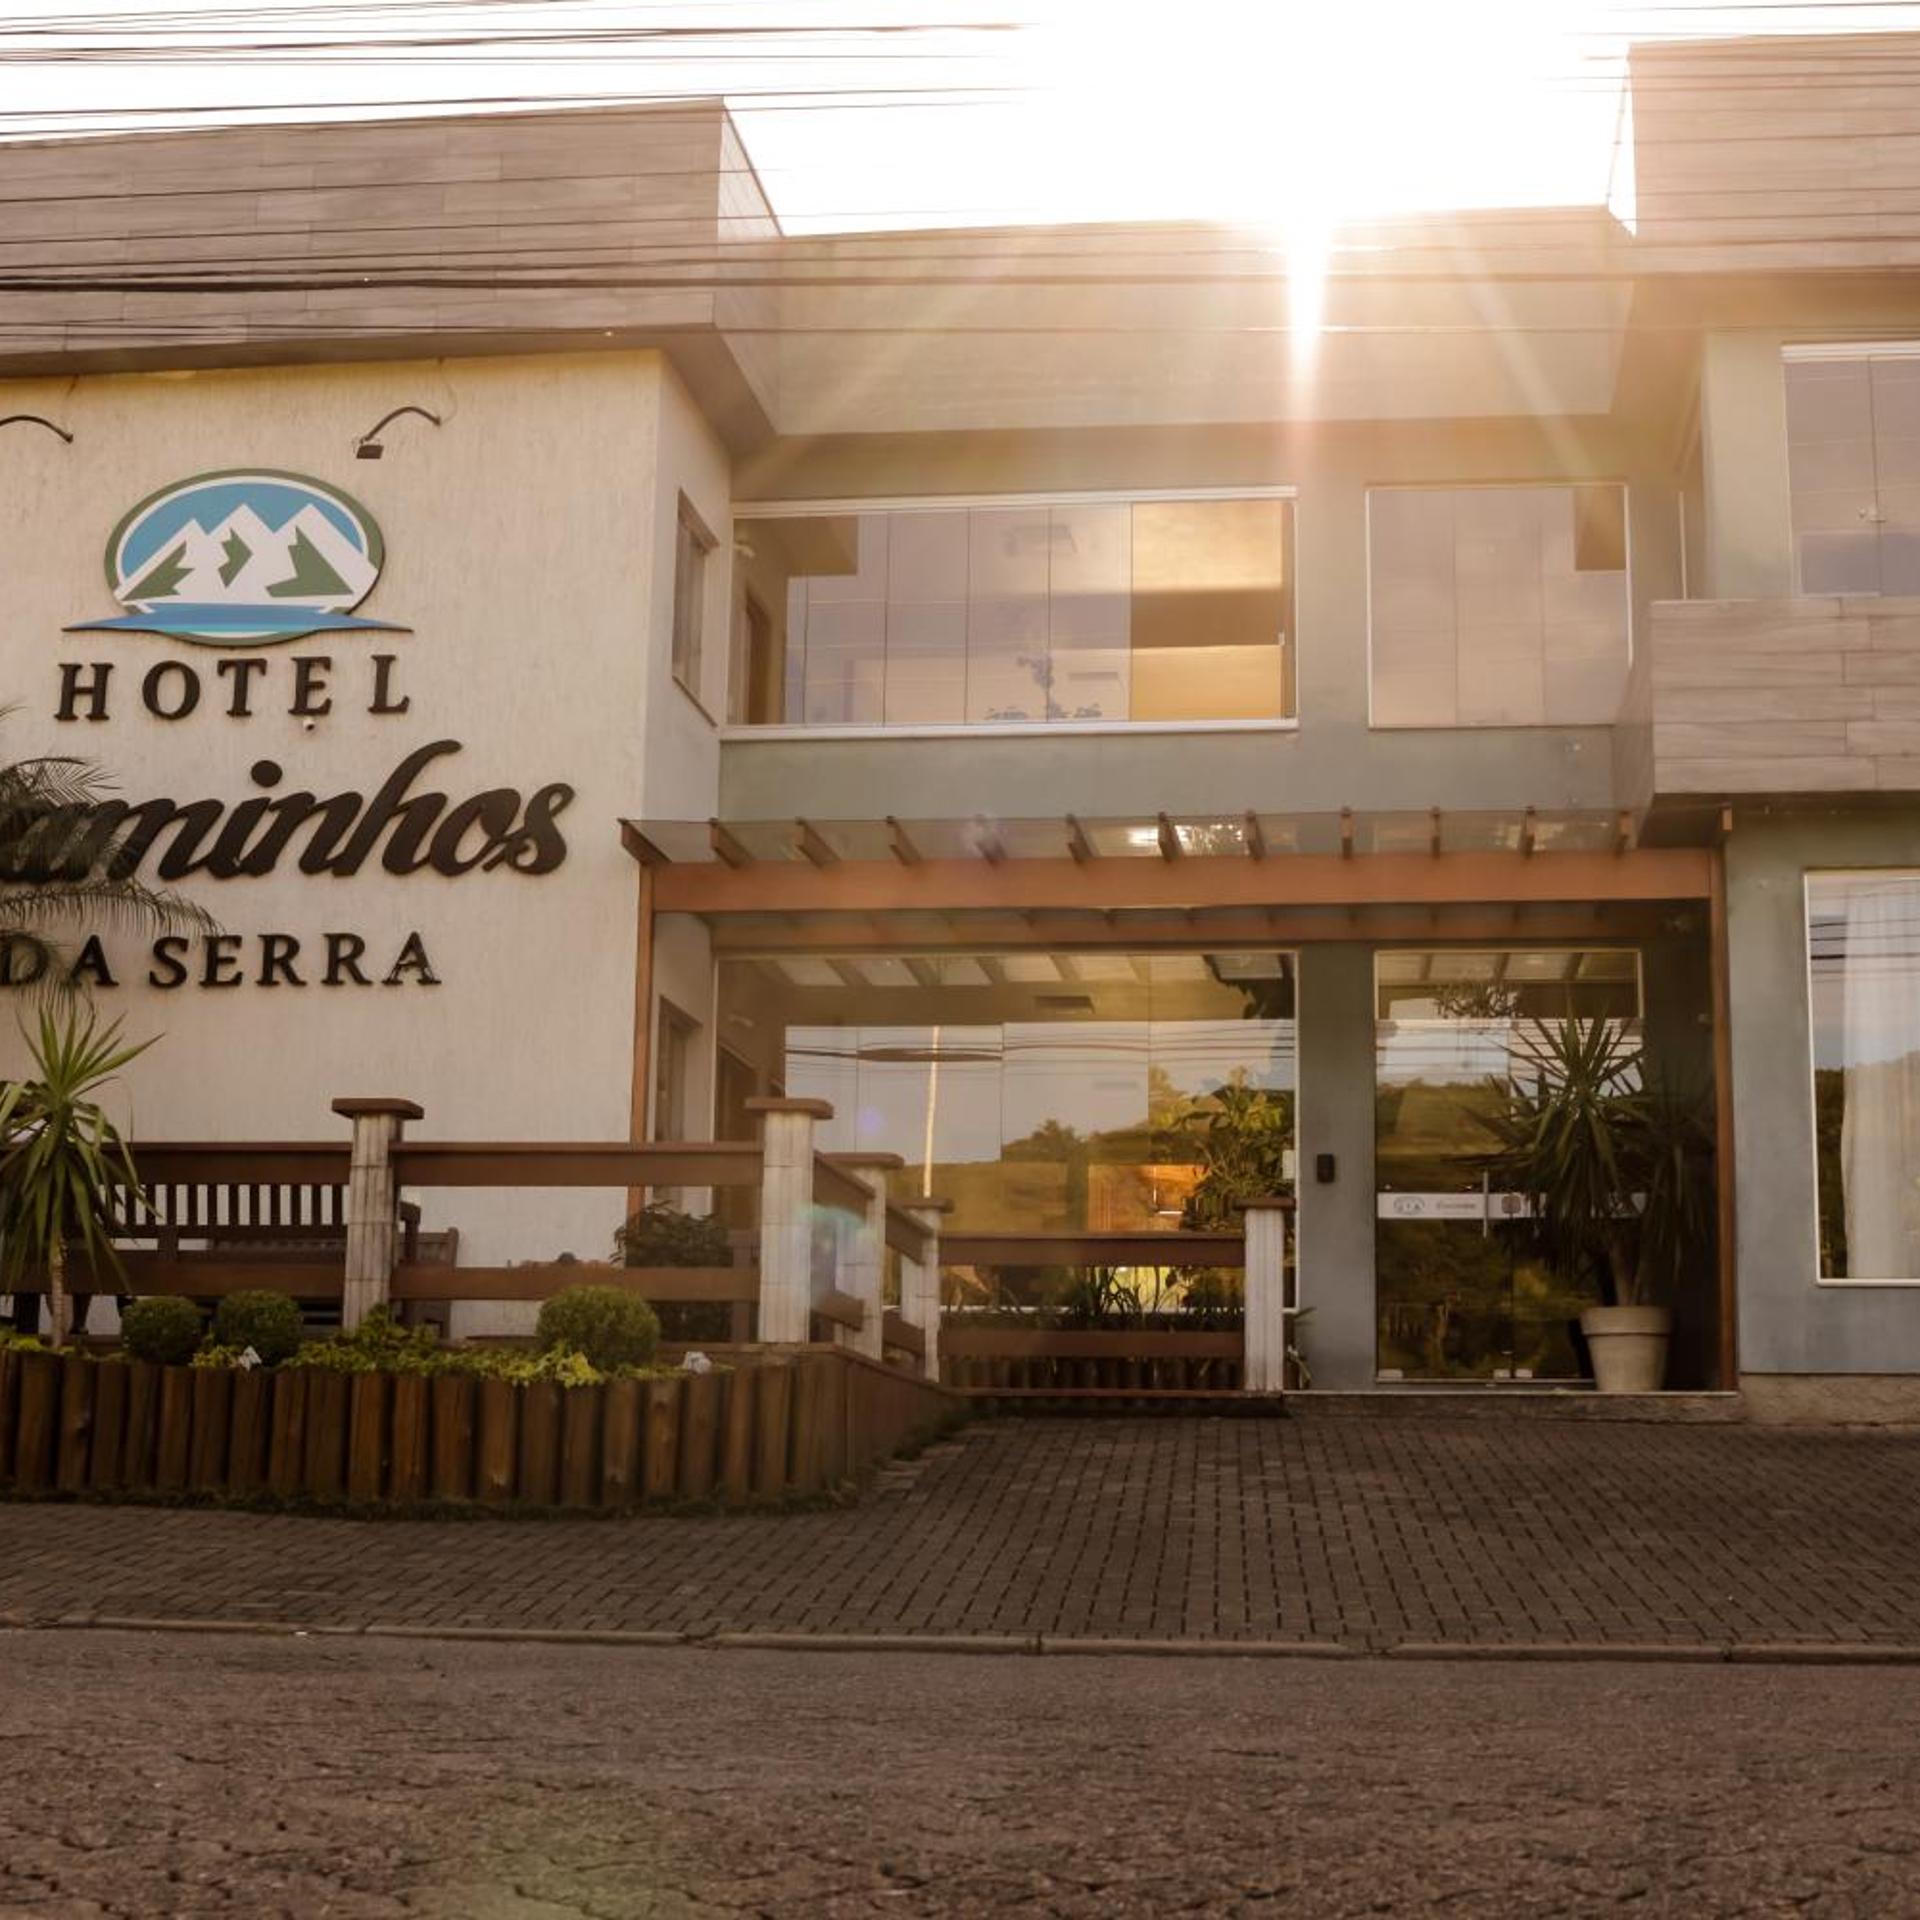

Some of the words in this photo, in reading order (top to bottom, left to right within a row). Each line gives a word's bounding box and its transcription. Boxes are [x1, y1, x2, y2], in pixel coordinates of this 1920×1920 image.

[55, 654, 411, 721] HOTEL
[0, 933, 119, 987] DA
[149, 932, 442, 988] SERRA
